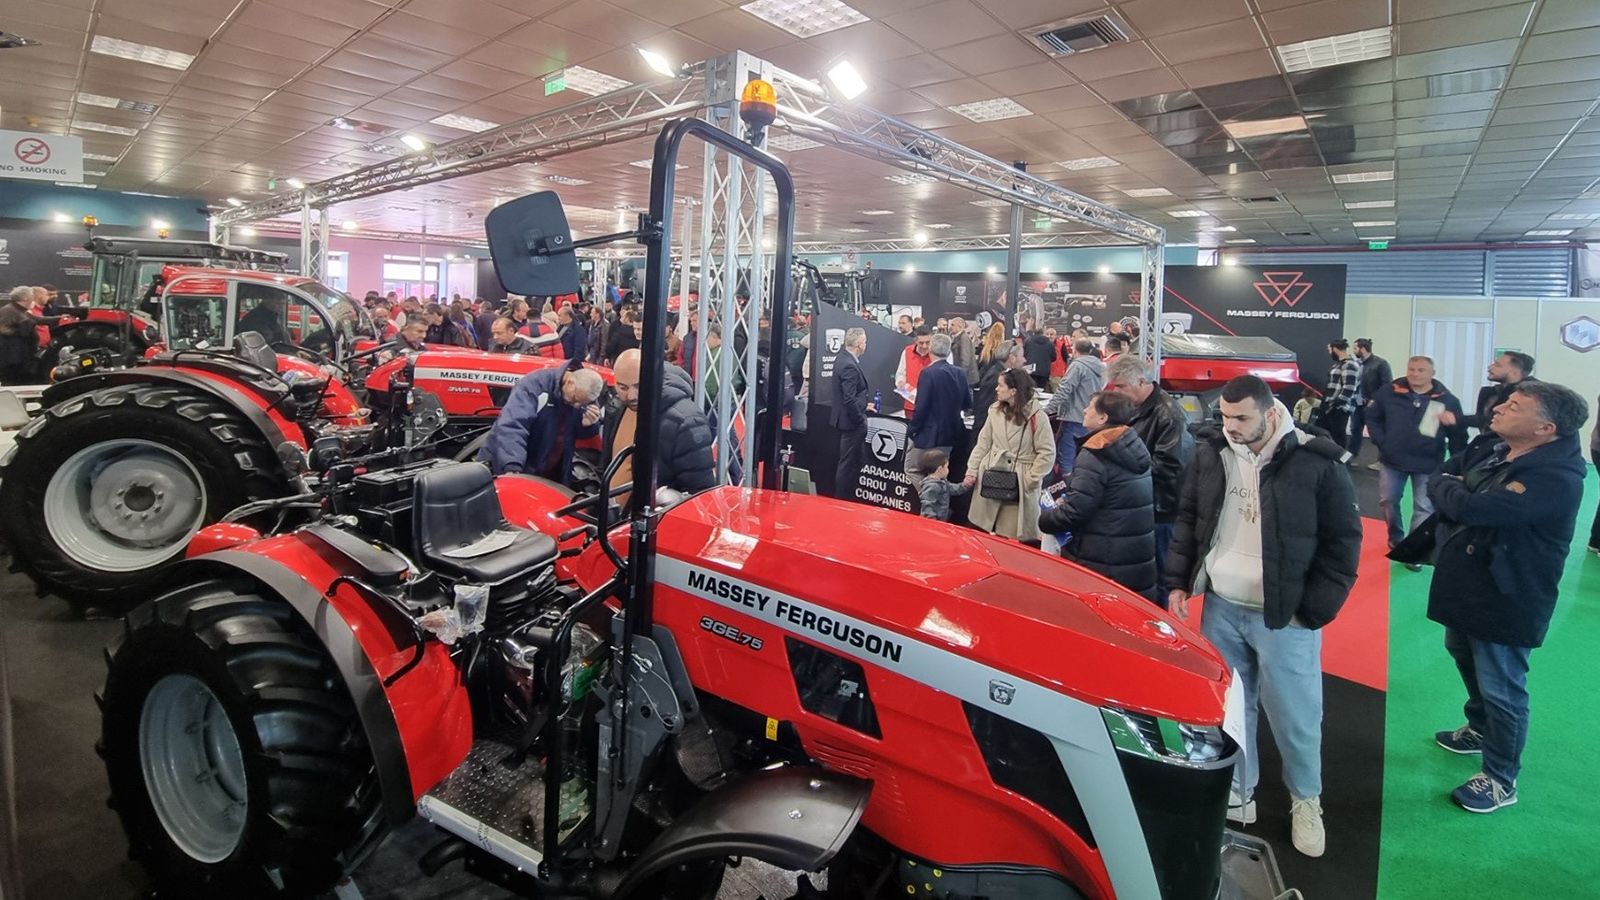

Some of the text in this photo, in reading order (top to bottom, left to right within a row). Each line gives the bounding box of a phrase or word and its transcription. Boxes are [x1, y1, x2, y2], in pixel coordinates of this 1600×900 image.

[19, 166, 67, 175] SMOKING
[1226, 309, 1340, 319] MASSEY FERGUSON
[440, 371, 480, 380] MASSEY
[860, 464, 912, 485] ARACAKIS
[895, 485, 909, 497] OF
[855, 488, 912, 512] COMPANIES
[687, 570, 903, 663] MASSEY FERGUSON
[699, 616, 764, 652] 3GE.75
